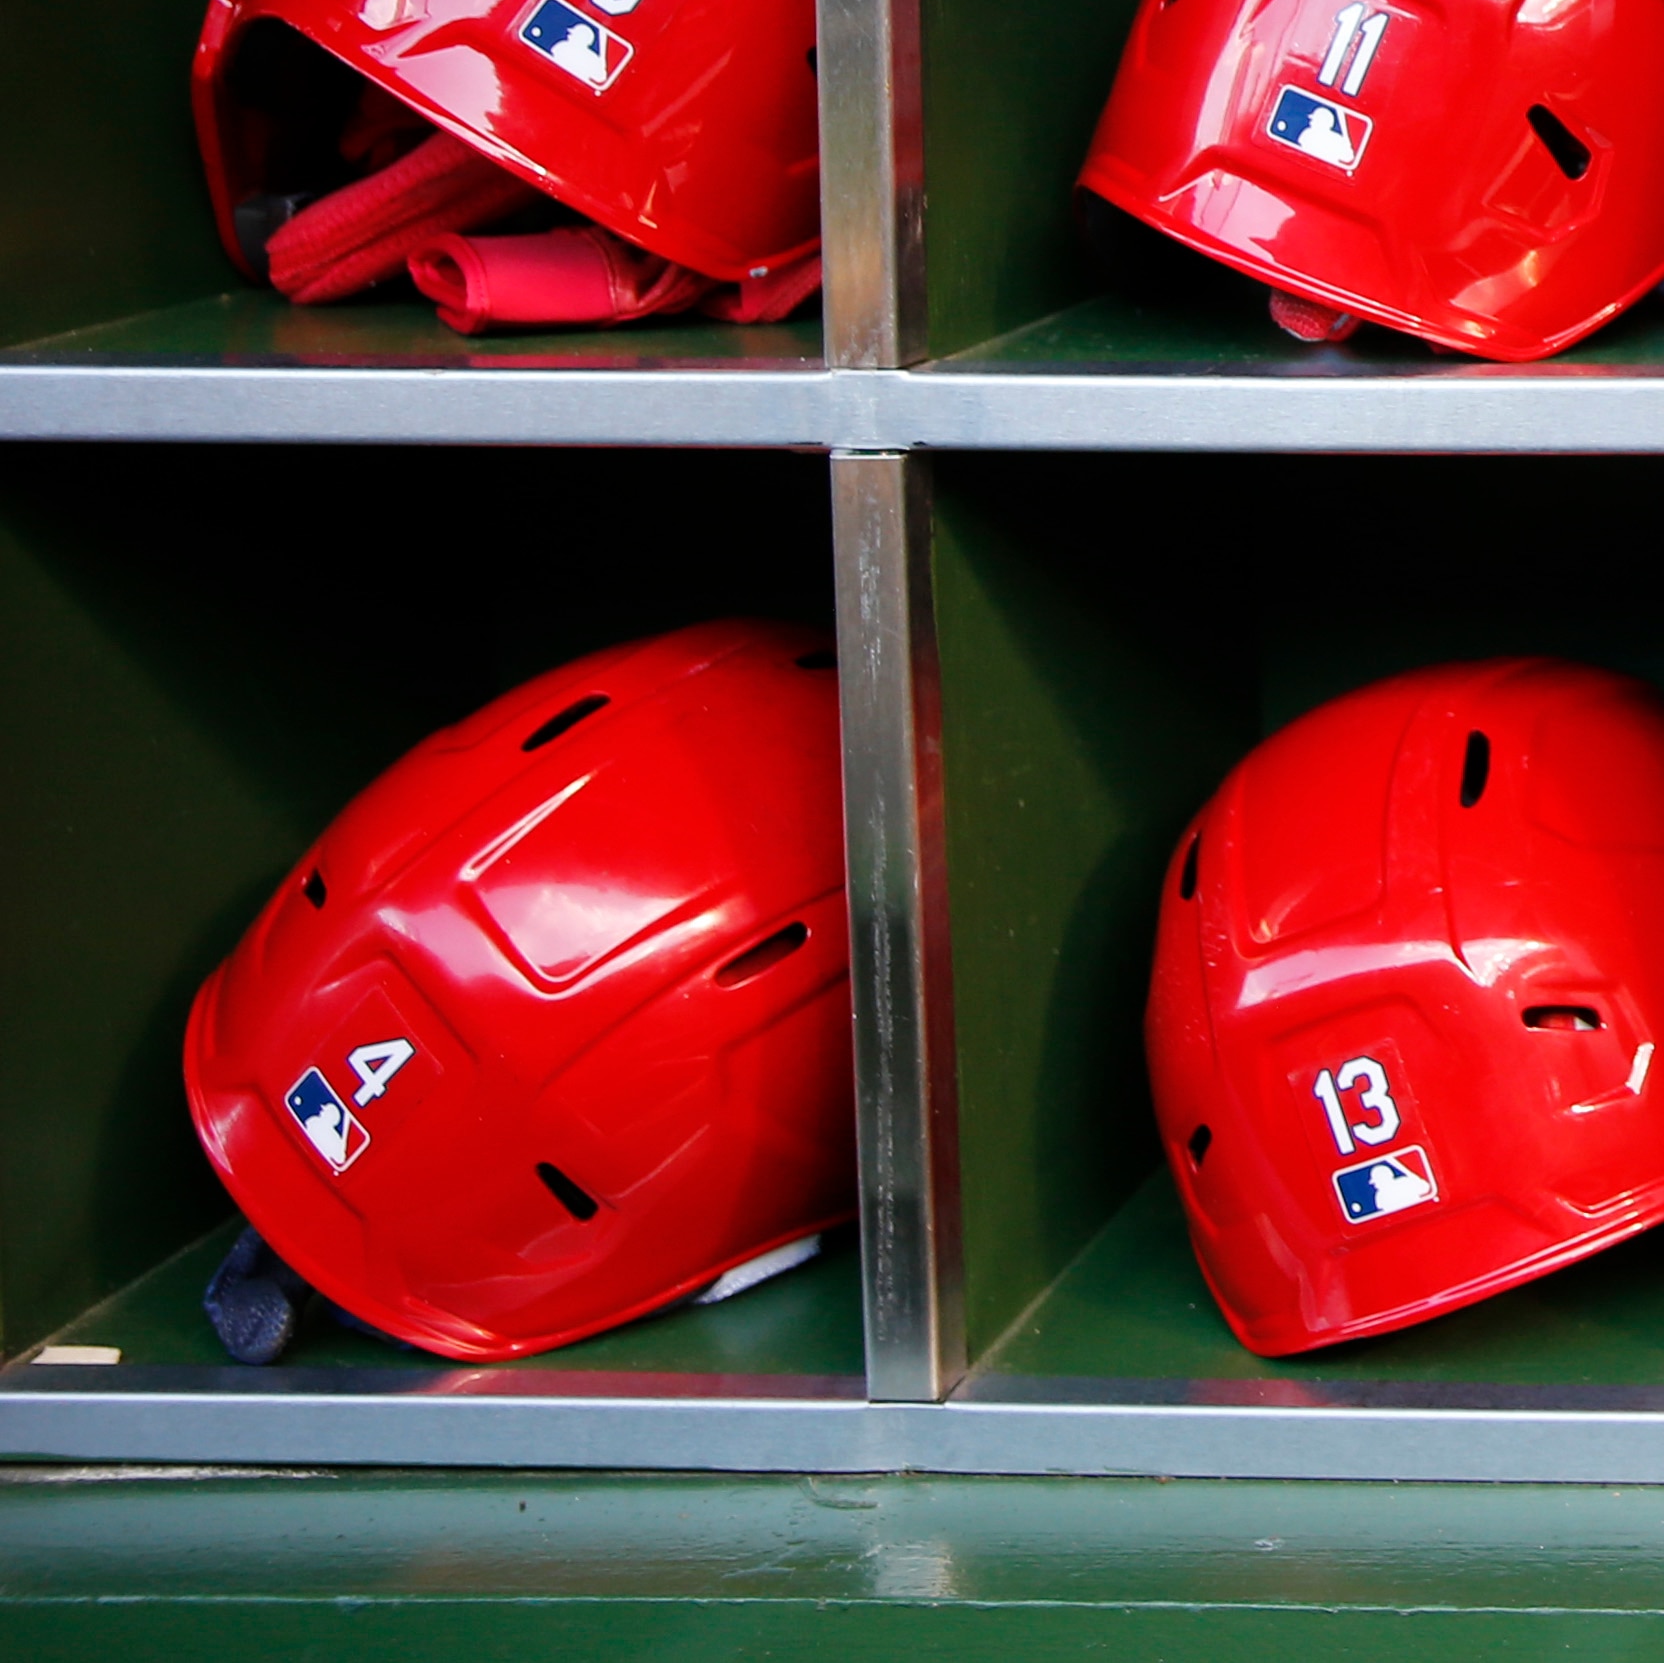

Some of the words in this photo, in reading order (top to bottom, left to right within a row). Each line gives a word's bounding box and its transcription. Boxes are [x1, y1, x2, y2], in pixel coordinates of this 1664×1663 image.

[1316, 1, 1390, 97] 11
[345, 1037, 416, 1108] 4
[1313, 1056, 1401, 1156] 13
